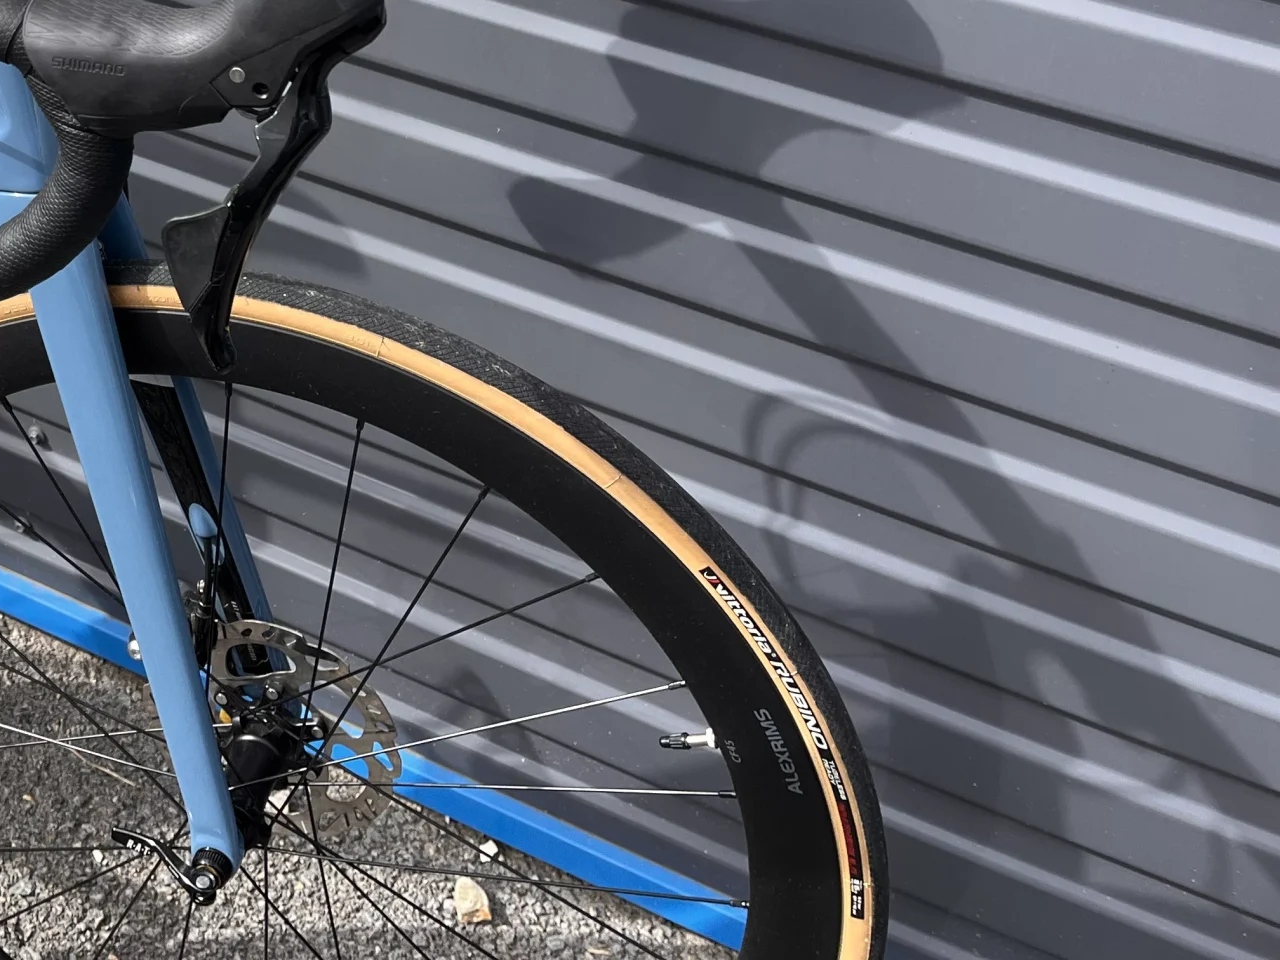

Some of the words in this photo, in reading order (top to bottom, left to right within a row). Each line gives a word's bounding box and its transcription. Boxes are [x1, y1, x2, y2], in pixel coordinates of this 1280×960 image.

[51, 56, 126, 77] SHIMANO
[769, 660, 828, 750] RUBINO
[753, 707, 804, 796] ALEXRIMS
